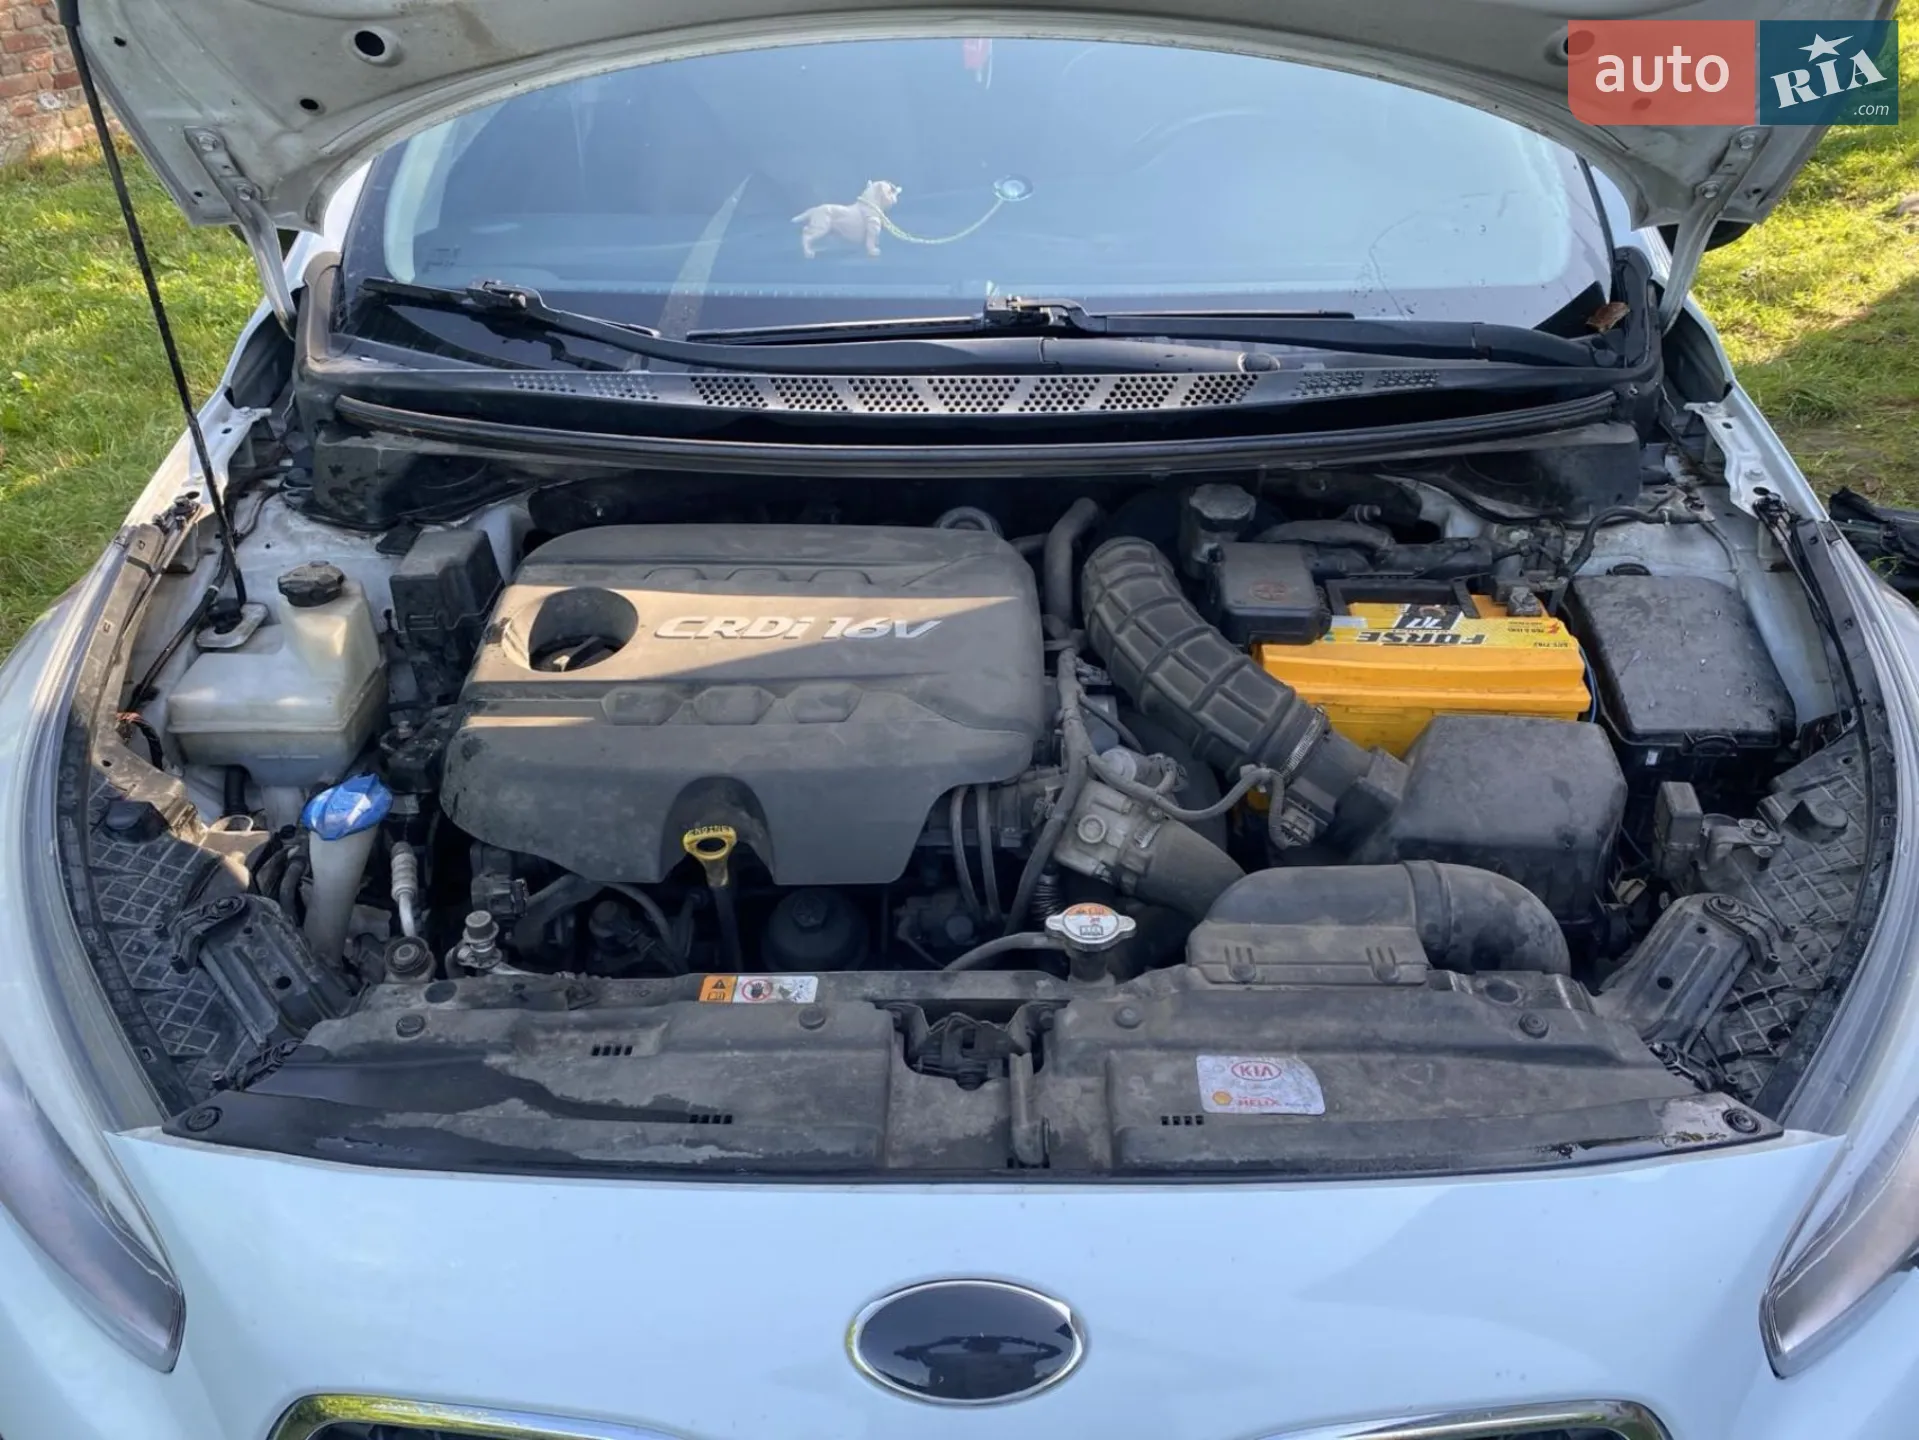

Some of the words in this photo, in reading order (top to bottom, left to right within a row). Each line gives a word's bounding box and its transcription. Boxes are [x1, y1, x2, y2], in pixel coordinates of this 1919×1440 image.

[654, 616, 815, 639] CRDi
[822, 616, 942, 639] 16V
[1356, 631, 1486, 644] FORSE
[1239, 1065, 1273, 1077] KIA
